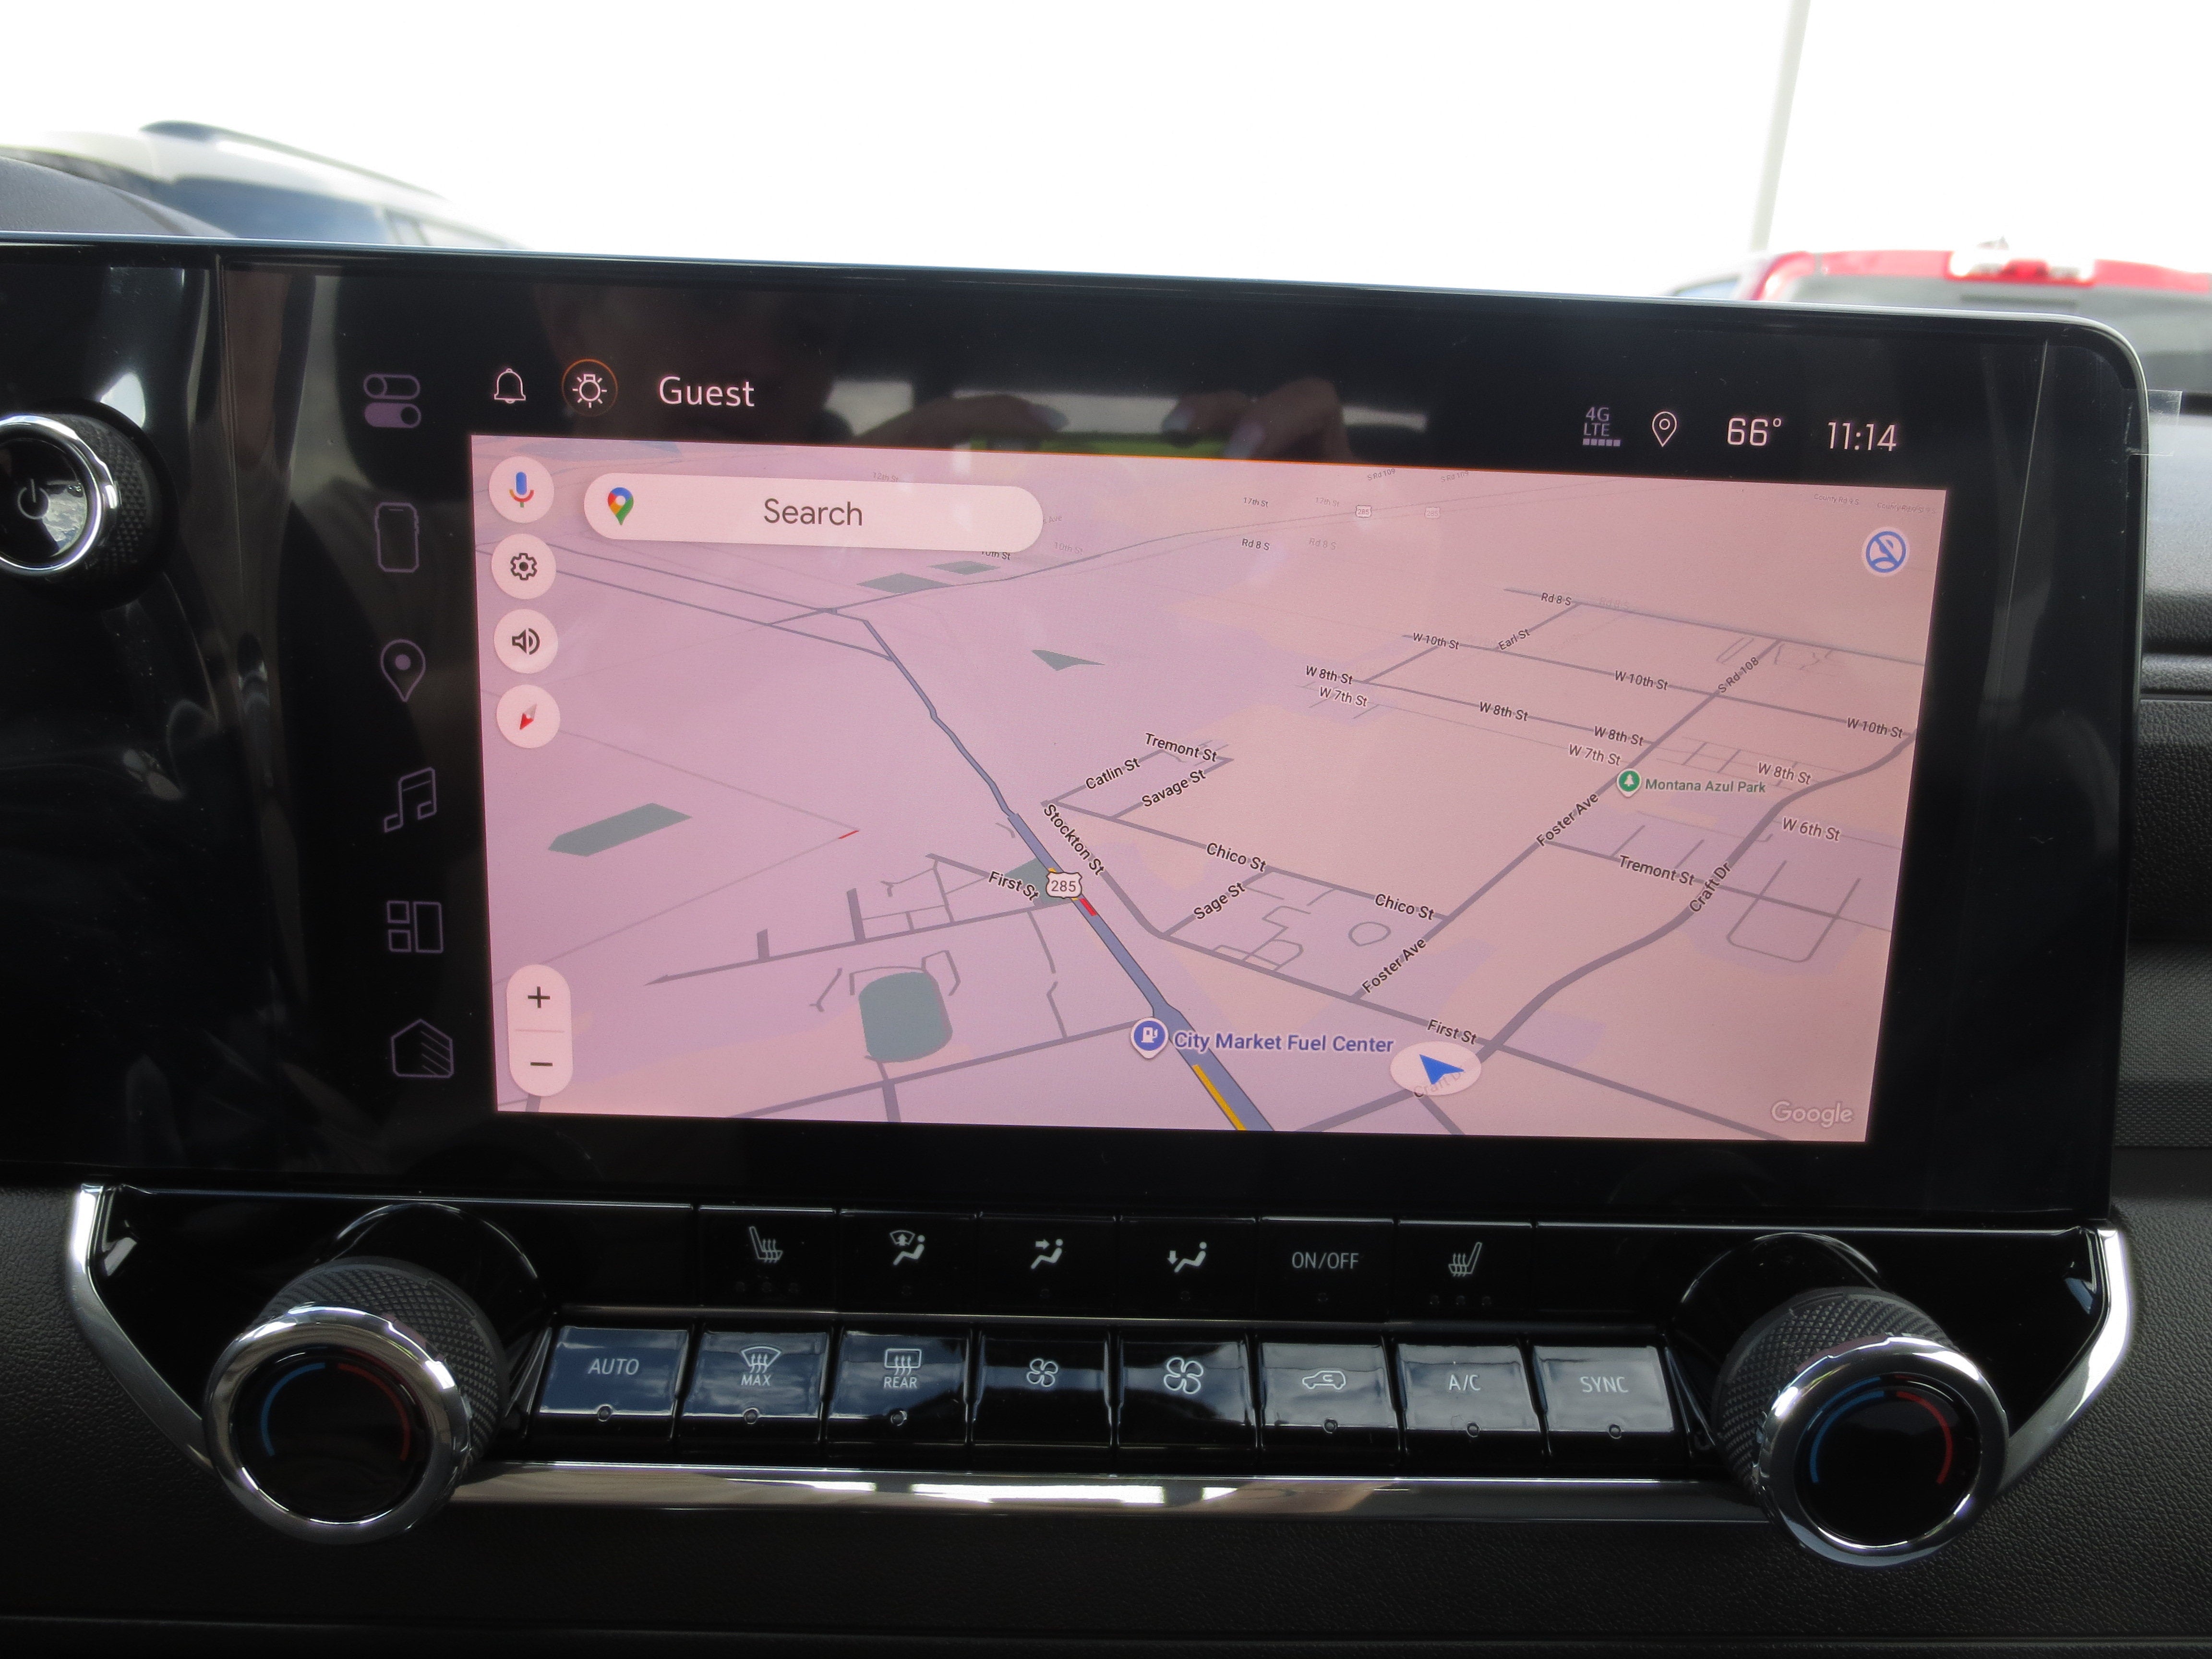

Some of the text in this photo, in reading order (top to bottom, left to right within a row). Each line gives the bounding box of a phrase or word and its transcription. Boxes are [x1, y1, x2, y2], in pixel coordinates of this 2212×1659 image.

[659, 376, 755, 408] Guest
[1586, 407, 1610, 421] 4G
[1583, 422, 1611, 437] LTE
[1827, 421, 1897, 452] 11:14
[1383, 468, 1395, 477] 109
[1243, 497, 1269, 508] 17th St
[1315, 497, 1331, 505] 17th
[1814, 493, 1837, 503] County
[763, 498, 863, 526] Search
[1242, 539, 1254, 549] Rd
[1263, 542, 1270, 551] S
[1309, 538, 1322, 548] Rd
[1001, 552, 1010, 560] St
[1541, 592, 1572, 605] Rd 8 S
[1413, 632, 1424, 642] W
[1426, 635, 1446, 648] 10th
[1449, 638, 1459, 650] St
[1498, 634, 1518, 650] Earl
[1518, 628, 1530, 639] St
[1305, 665, 1353, 685] W 8th St
[1614, 671, 1668, 691] W 10th St
[1717, 657, 1759, 694] S Rd 108
[1319, 686, 1368, 708] W 7th St
[1479, 701, 1528, 721] W 8th St
[1594, 726, 1644, 746] W 8th St
[1847, 718, 1902, 739] W 10th St
[1145, 733, 1217, 762] Tremont St
[1568, 745, 1620, 767] W 7th St
[1085, 757, 1140, 790] Catlin St
[1757, 763, 1811, 785] W 8th St
[1142, 769, 1206, 807] Savage St
[1645, 780, 1767, 793] Montana Azul Park
[1536, 792, 1599, 847] Foster Ave
[1782, 817, 1840, 842] W 6th St
[1044, 804, 1105, 876] Stockton St
[1206, 842, 1267, 872] Chico St
[1619, 855, 1695, 886] Tremont St
[987, 871, 1039, 902] First St
[1050, 880, 1077, 893] 285
[1690, 862, 1732, 913] Craft Dr
[1193, 881, 1246, 920] Sage St
[1375, 894, 1434, 921] Chico St
[1361, 937, 1427, 994] Foster Ave
[1428, 1018, 1478, 1046] First St
[1174, 1033, 1394, 1053] City Market Fuel Center
[1770, 1100, 1854, 1128] Google
[1292, 1251, 1359, 1270] ON/OFF
[588, 1358, 639, 1376] AUTO
[741, 1374, 771, 1386] MAX
[883, 1376, 917, 1389] REAR
[1449, 1374, 1481, 1392] A/C
[1580, 1375, 1629, 1393] SYNC
